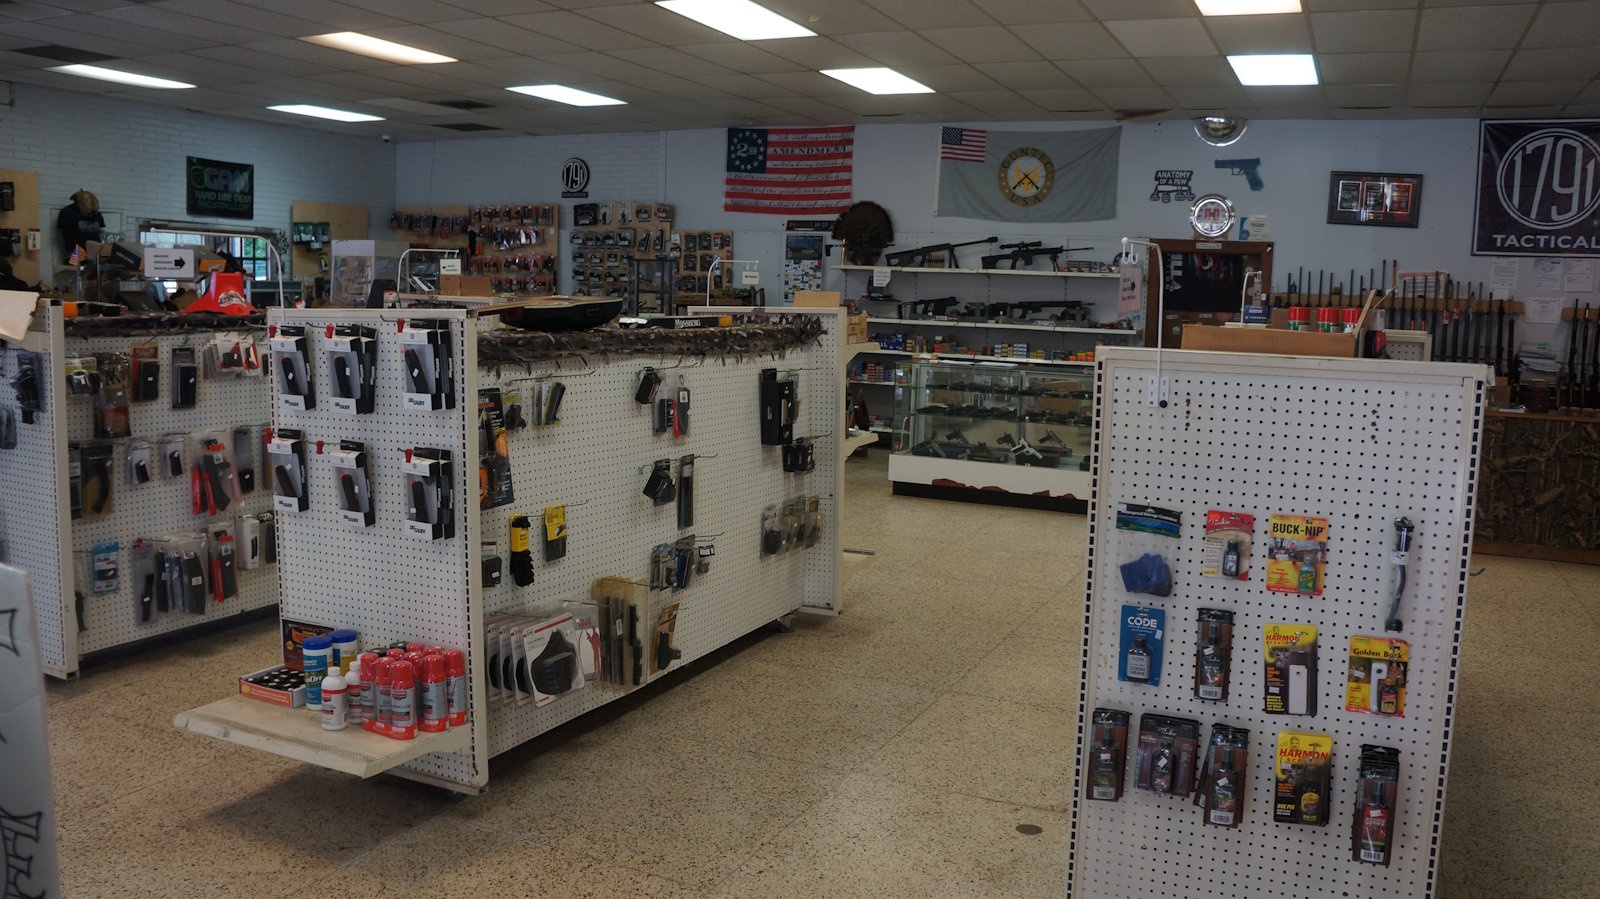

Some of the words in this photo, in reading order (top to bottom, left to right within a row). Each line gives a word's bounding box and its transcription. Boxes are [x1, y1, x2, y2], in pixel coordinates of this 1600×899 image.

[772, 146, 848, 154] AMENDMENT
[1001, 148, 1054, 170] GUNTEC
[563, 161, 584, 189] 1791
[1156, 171, 1191, 179] ANATOMY
[1512, 136, 1596, 221] 1791
[195, 190, 217, 200] HARD
[217, 192, 233, 202] USE
[1010, 194, 1043, 206] USA
[1492, 233, 1600, 249] TACTICAL
[1272, 522, 1324, 537] BUCK-NIP
[1127, 616, 1158, 628] CODE
[1353, 648, 1381, 657] Golden
[1383, 650, 1403, 659] Buck
[1279, 748, 1329, 760] HARMON
